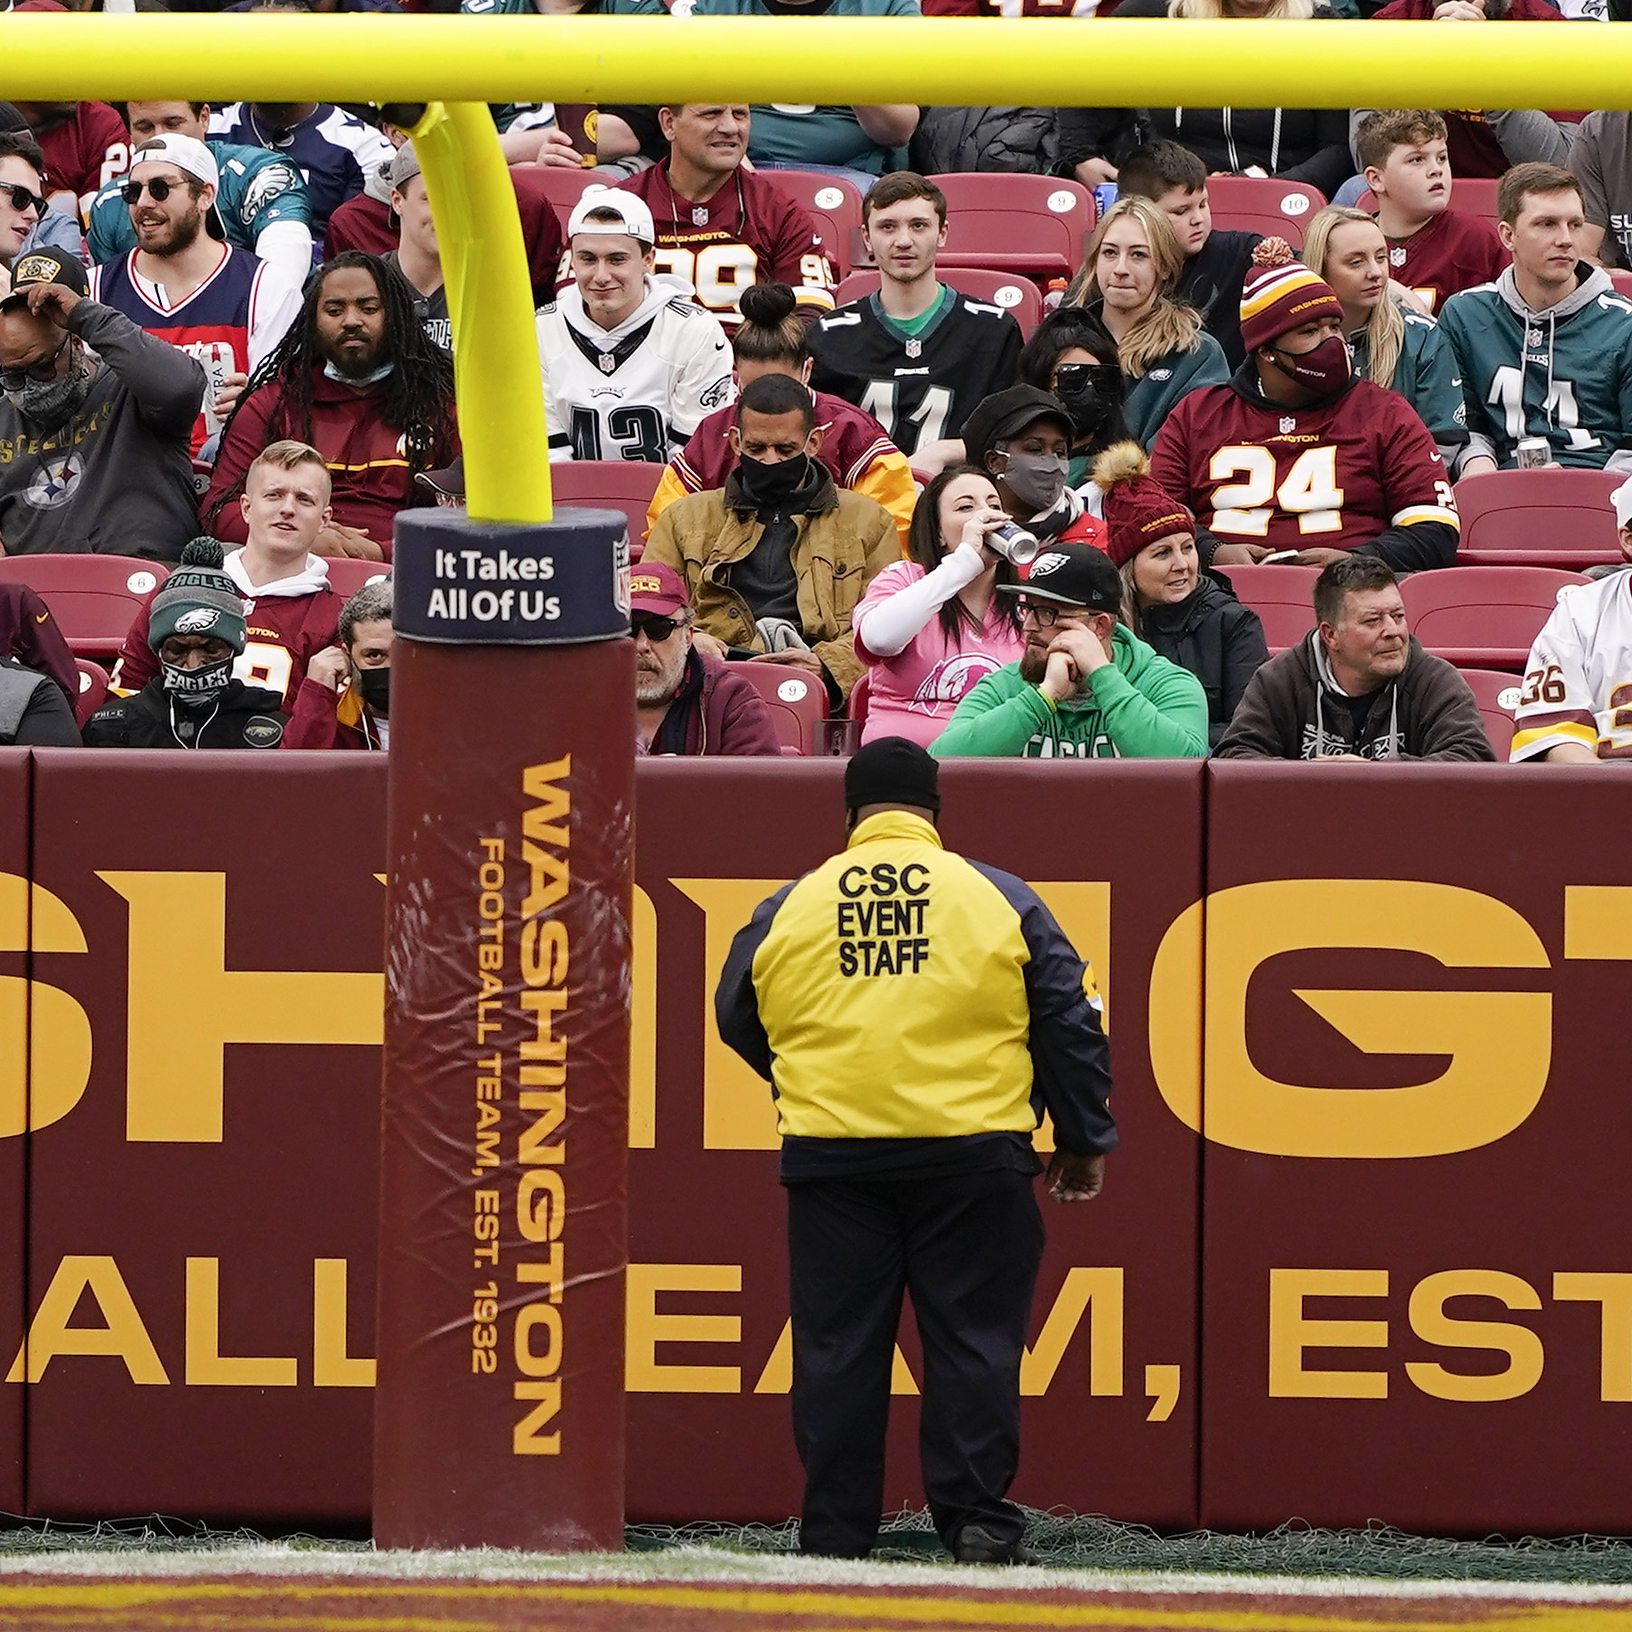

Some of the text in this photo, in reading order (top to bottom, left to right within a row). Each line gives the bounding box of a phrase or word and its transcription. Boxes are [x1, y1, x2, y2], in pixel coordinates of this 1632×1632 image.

[1287, 196, 1305, 212] 10
[657, 231, 735, 245] WASHINGTON
[864, 380, 954, 450] 11
[1487, 380, 1604, 449] 11
[1209, 446, 1345, 536] 24
[163, 573, 238, 595] EAGLES
[436, 549, 555, 581] It Takes
[428, 589, 561, 621] All Of Us
[164, 669, 230, 690] EAGLES
[1521, 668, 1566, 706] 36
[838, 863, 930, 897] CSC
[838, 899, 930, 937] EVENT
[838, 937, 930, 977] STAFF
[472, 838, 504, 1374] FOOTBALL TEAM, EST. 1932
[513, 754, 571, 1455] WASHINGTON
